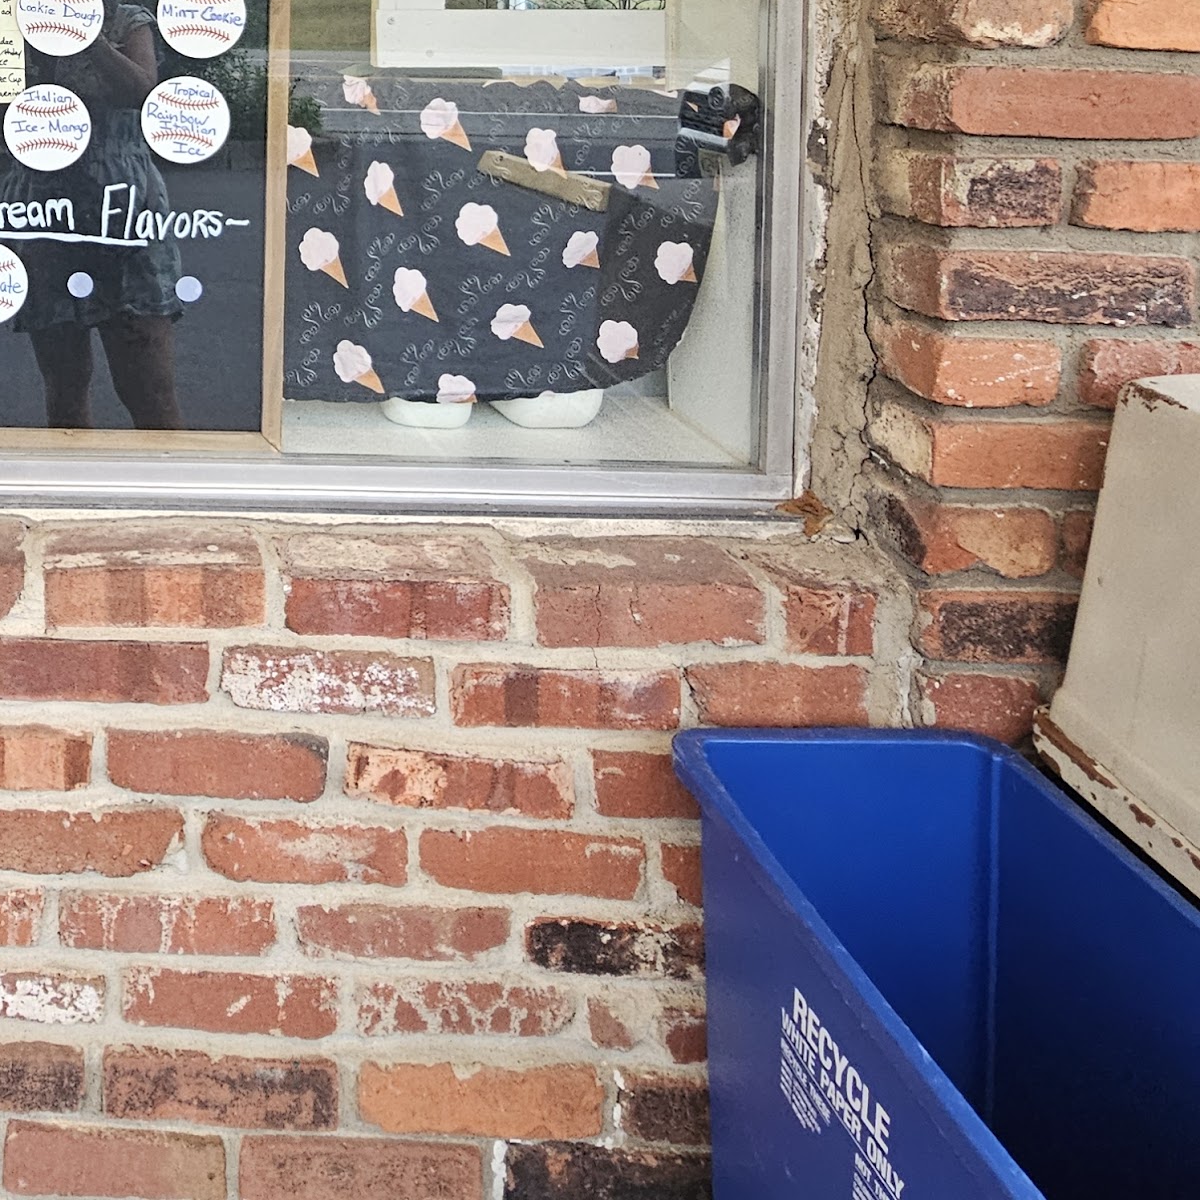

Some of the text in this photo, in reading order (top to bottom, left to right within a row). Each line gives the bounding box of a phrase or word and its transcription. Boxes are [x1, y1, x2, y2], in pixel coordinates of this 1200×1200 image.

[62, 2, 103, 28] Dough
[200, 6, 243, 27] Cookie
[8, 72, 22, 86] Cup
[23, 90, 72, 103] Italian
[168, 81, 215, 101] Tropical
[146, 102, 210, 127] Rainbow
[158, 120, 217, 136] Italian
[172, 141, 206, 157] Ice
[793, 986, 891, 1155] RECYCLE
[781, 1006, 816, 1076] WHITE
[820, 1067, 862, 1143] PAPER
[866, 1136, 905, 1200] ONLY
[854, 1152, 872, 1183] NOT
